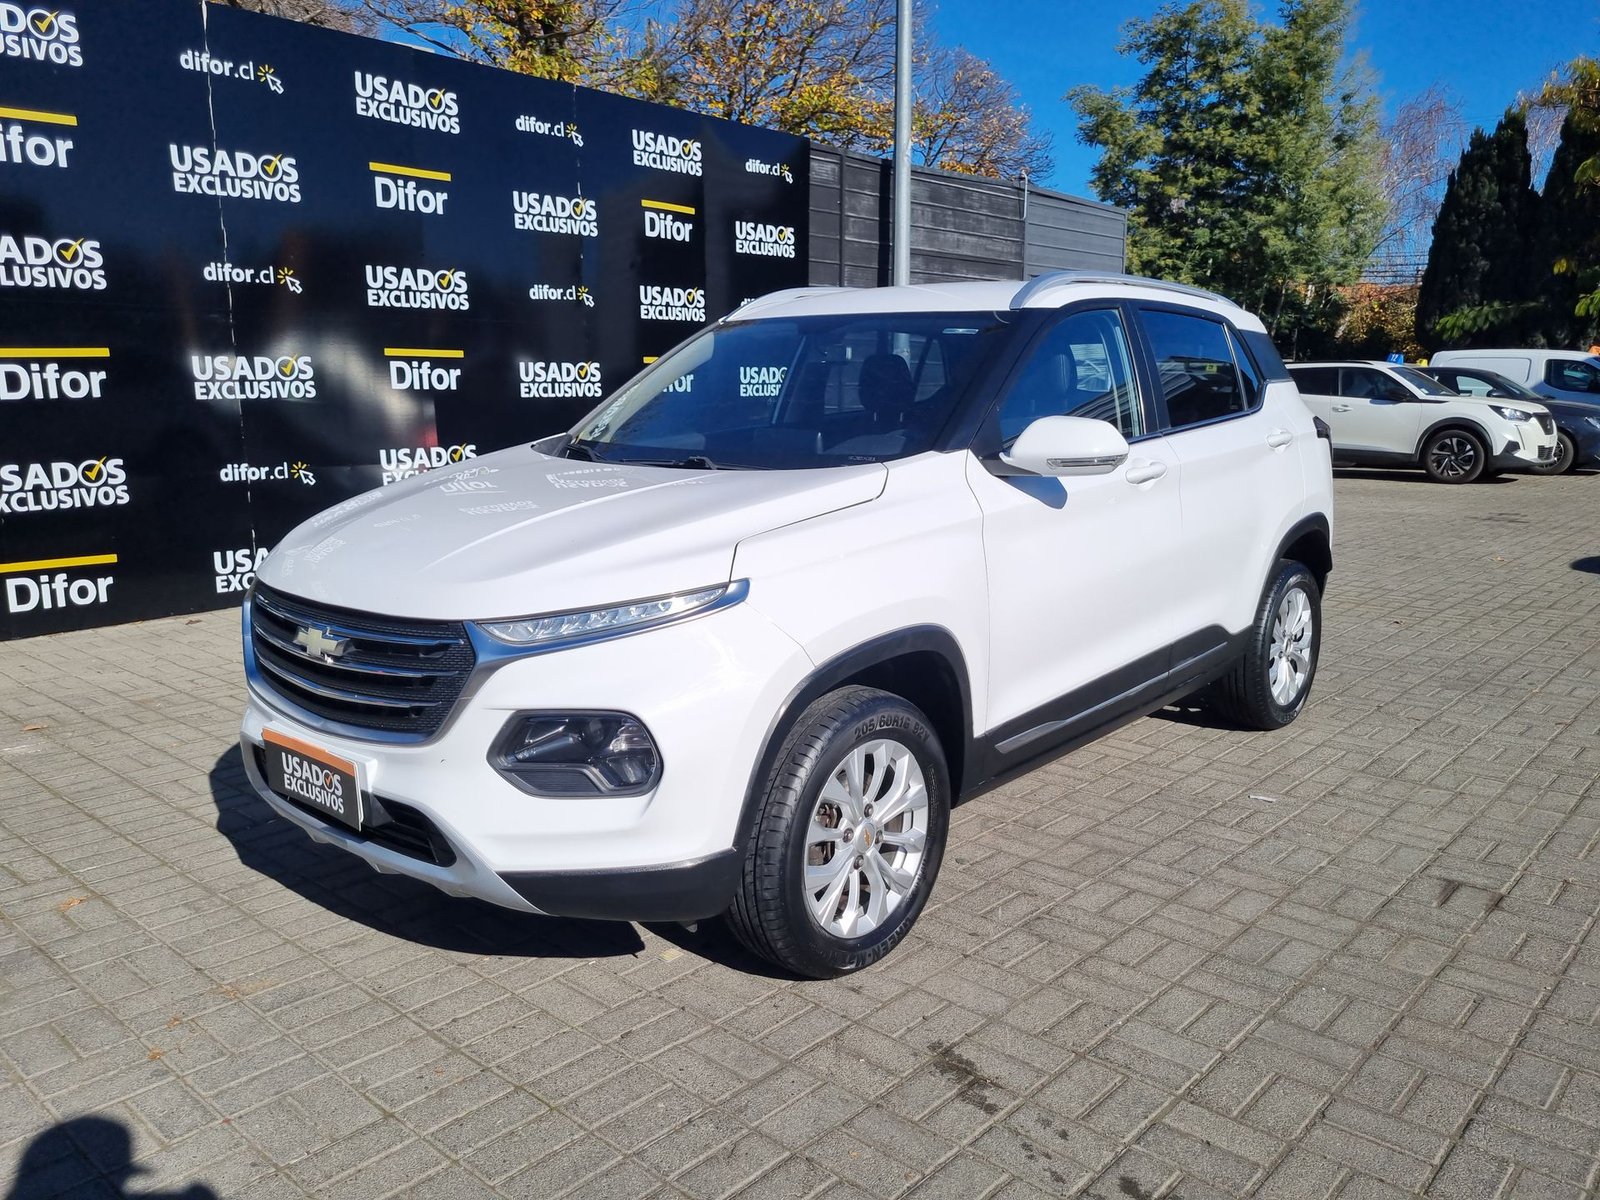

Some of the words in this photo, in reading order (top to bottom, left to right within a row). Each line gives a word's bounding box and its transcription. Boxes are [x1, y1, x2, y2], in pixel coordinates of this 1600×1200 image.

[0, 33, 84, 67] SIVOS
[179, 49, 255, 80] difor.cl
[354, 71, 459, 116] USADOS
[355, 97, 461, 134] EXCLUSIVOS
[515, 115, 565, 137] difor.cl
[632, 129, 702, 161] USADOS
[169, 144, 300, 183] USADOS
[633, 151, 703, 177] EXCLUSIVOS
[745, 159, 780, 176] difor.cl
[172, 172, 302, 203] EXCLUSIVOS
[374, 176, 448, 215] Difor
[512, 190, 598, 221] USADOS
[514, 213, 599, 237] EXCLUSIVOS
[644, 211, 693, 242] Difor
[735, 221, 795, 244] USADOS
[0, 235, 104, 269] ADOS
[735, 239, 796, 258] EXCLUSIVOS
[203, 262, 275, 284] difor.cl
[365, 264, 468, 293] USADOS
[367, 289, 470, 310] EXCLUSIVOS
[529, 284, 577, 301] difor.cl
[640, 285, 705, 308] USADOS
[640, 305, 706, 322] EXCLUSIVOS
[0, 362, 107, 400] Difor
[191, 354, 314, 382] USADOS
[389, 361, 461, 391] Difor
[519, 361, 601, 383] USADOS
[194, 380, 317, 400] EXCLUSIVOS
[520, 382, 602, 398] EXCLUSIVOS
[379, 443, 478, 472] USADOS
[0, 457, 127, 492] SADOS
[219, 462, 289, 483] difor.cl
[5, 573, 114, 613] Difor
[281, 752, 343, 796] USADOS
[284, 774, 344, 814] EXCLUSIVOS
